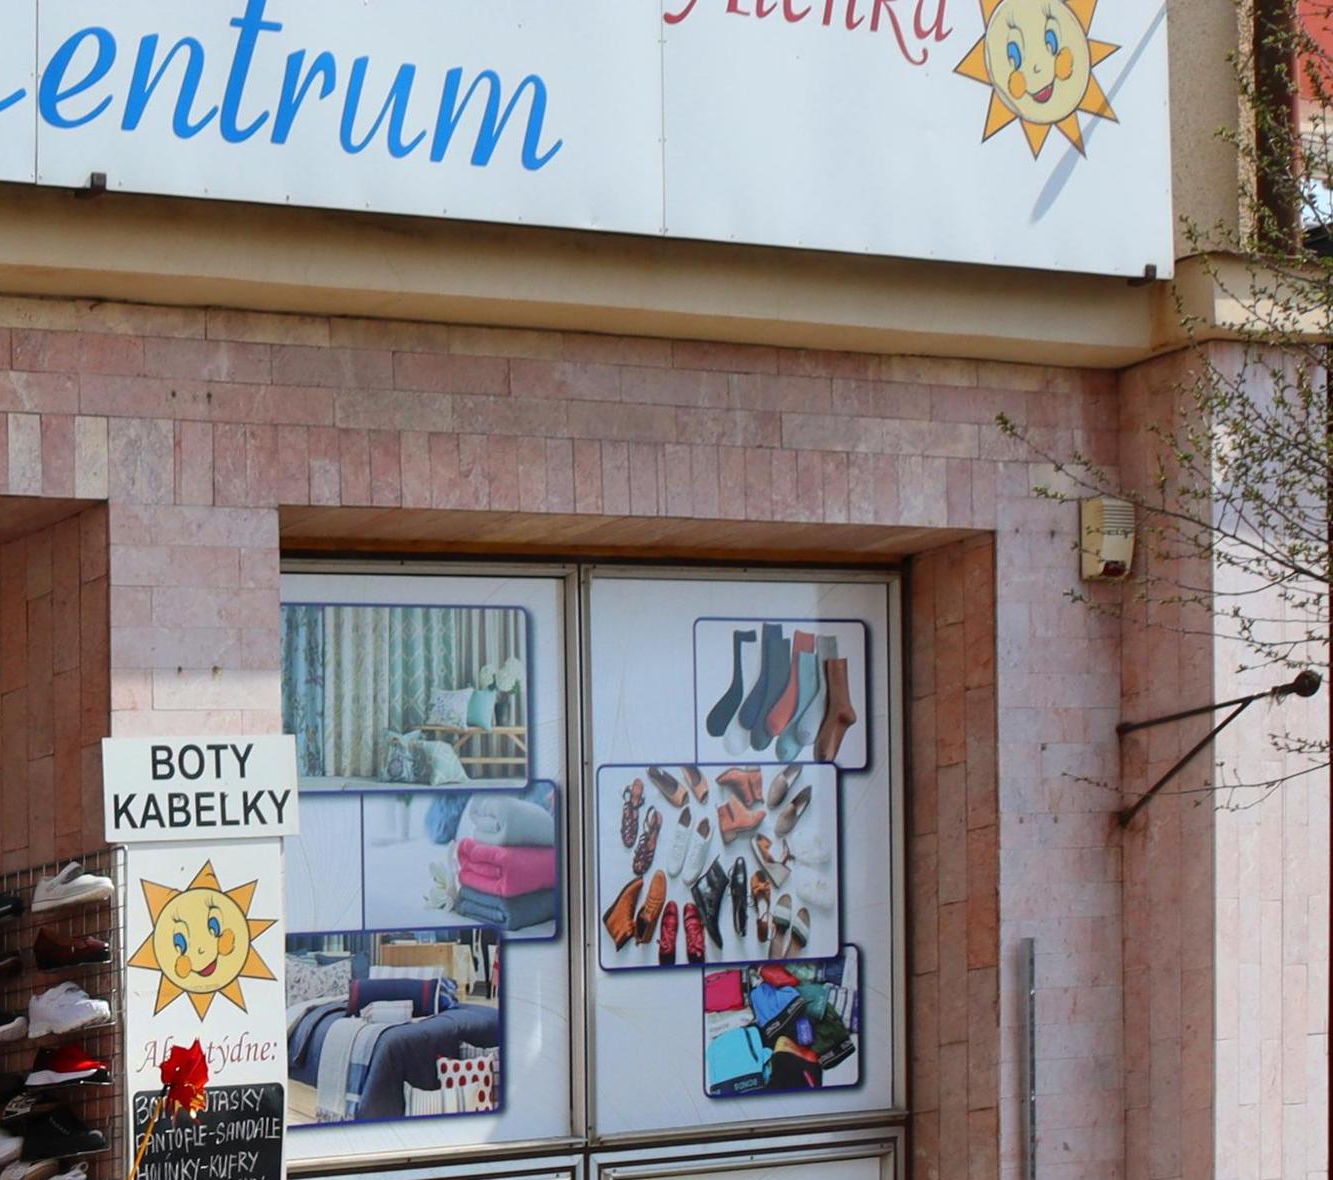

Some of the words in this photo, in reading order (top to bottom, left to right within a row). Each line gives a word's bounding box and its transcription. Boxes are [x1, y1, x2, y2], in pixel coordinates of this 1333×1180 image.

[150, 743, 254, 780] BOTY
[113, 789, 291, 829] KABELKY
[206, 1031, 278, 1074] týdne:
